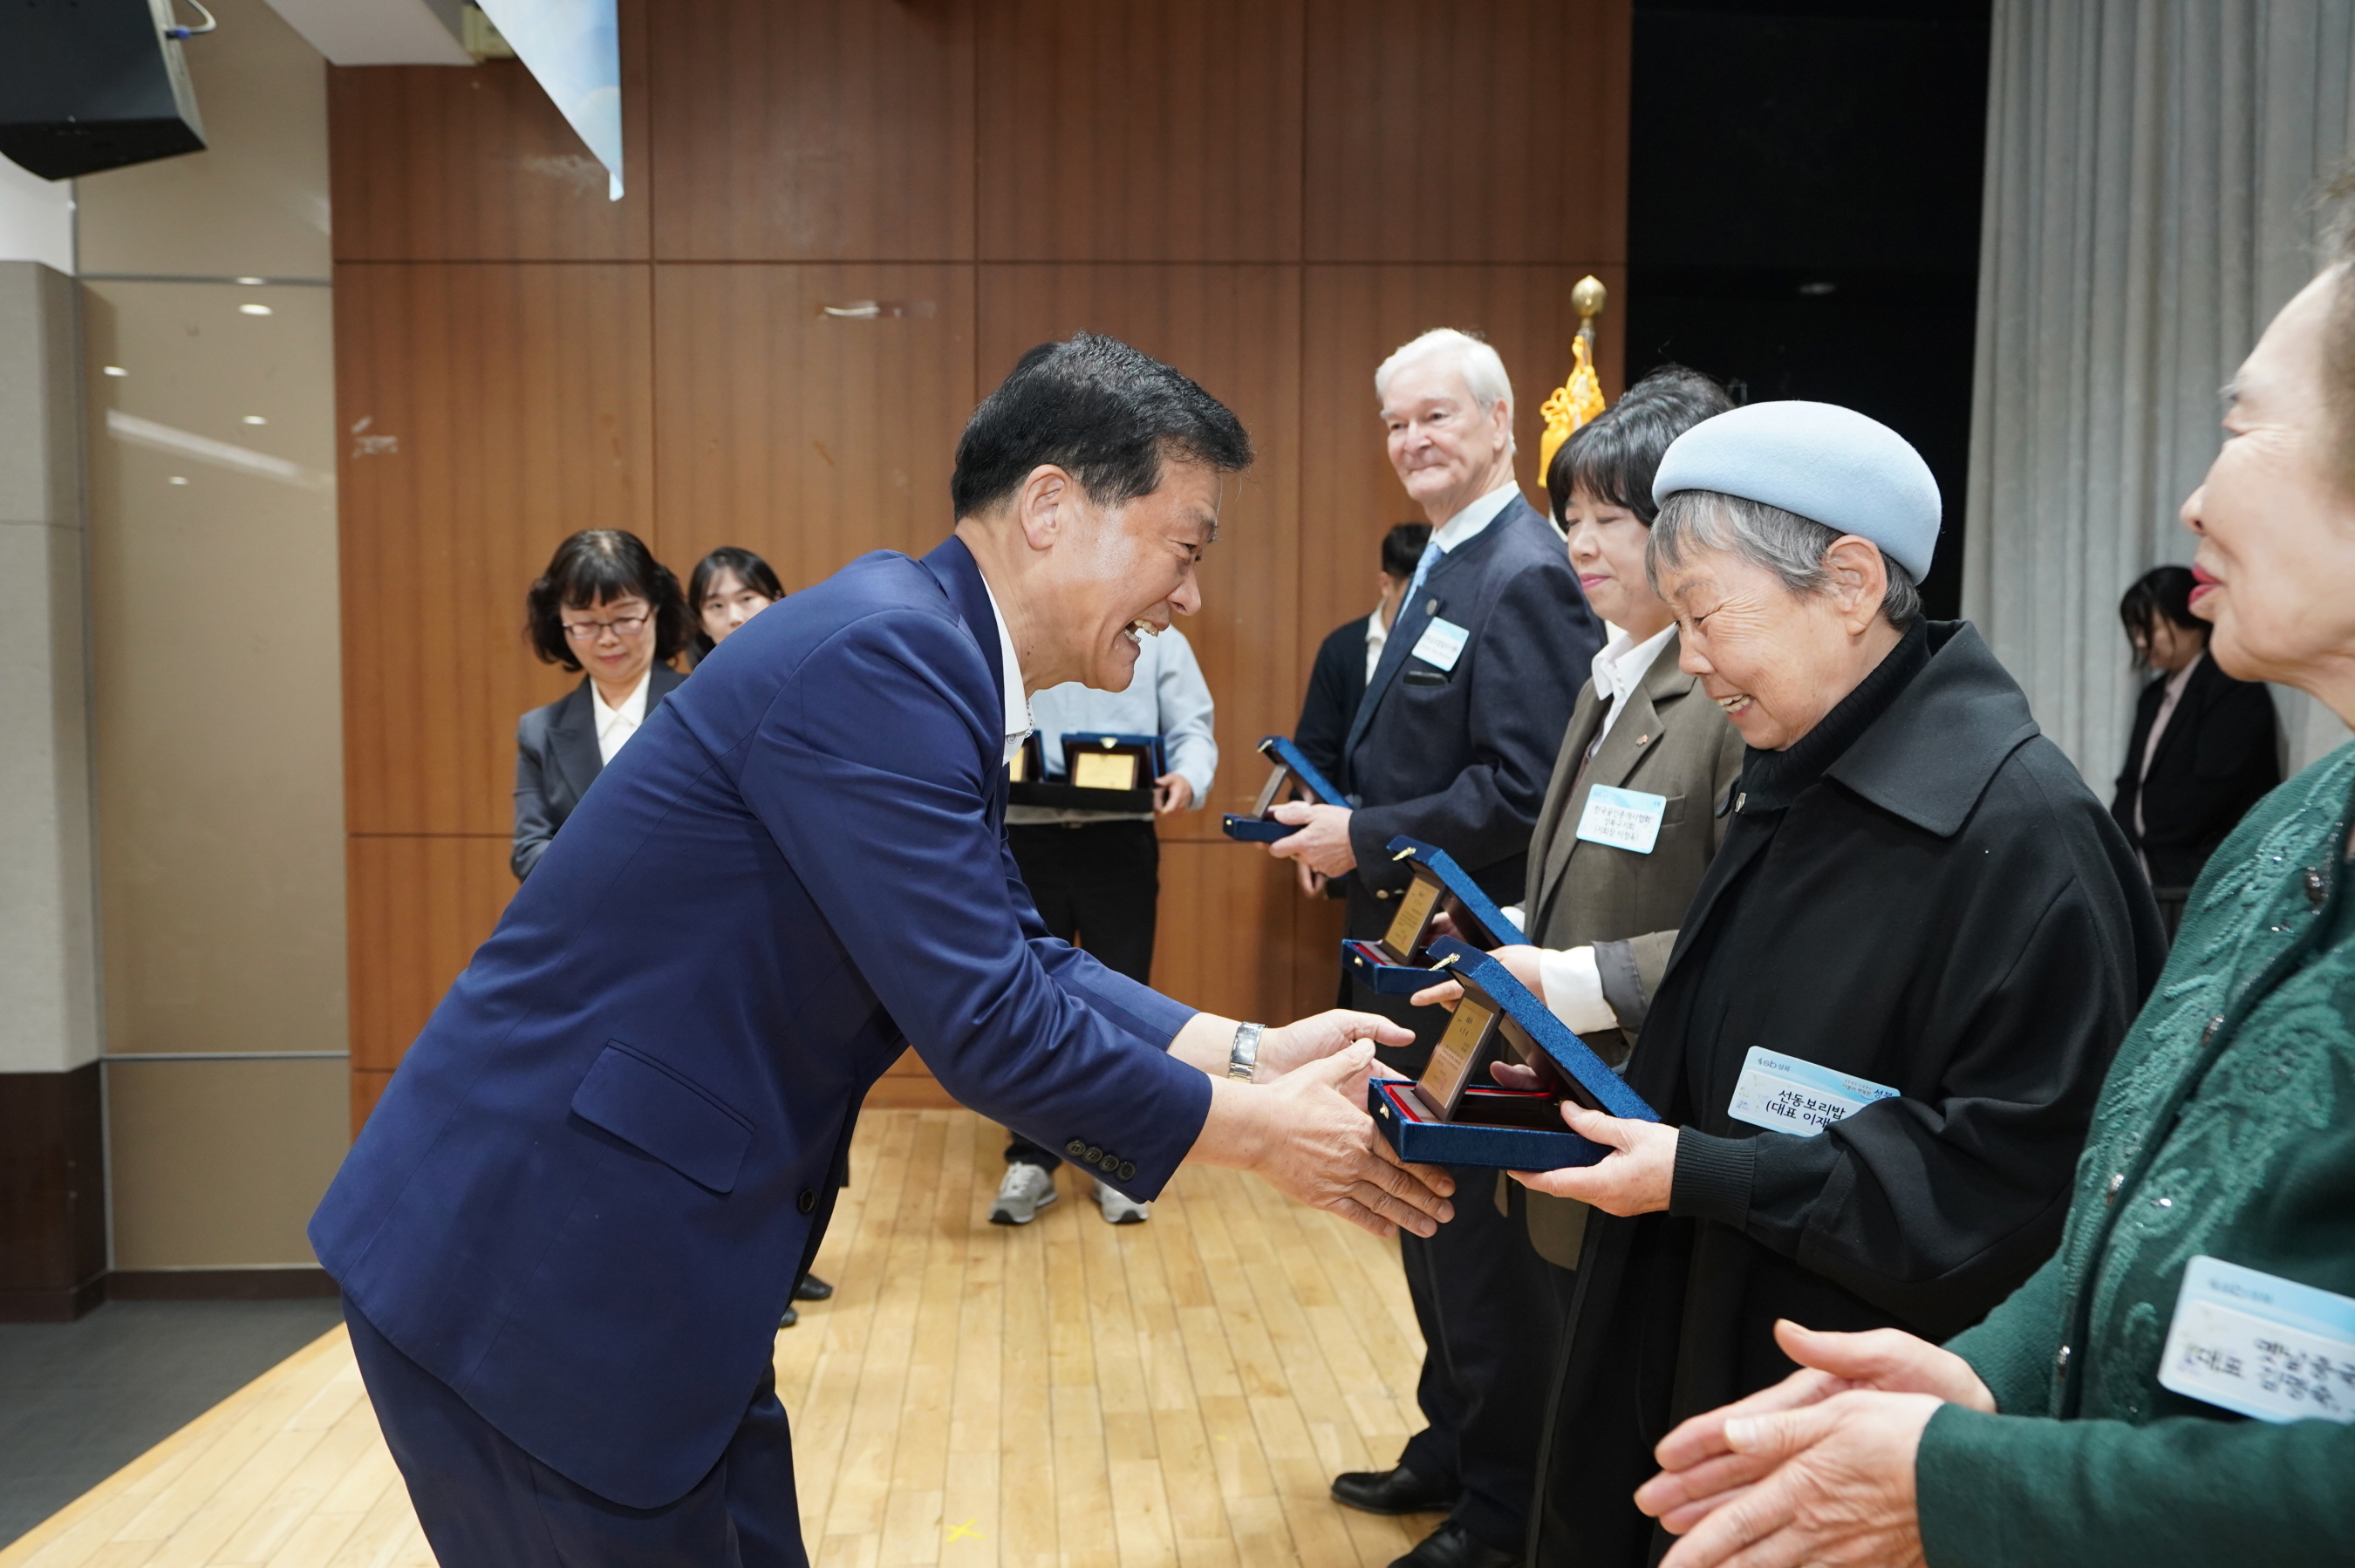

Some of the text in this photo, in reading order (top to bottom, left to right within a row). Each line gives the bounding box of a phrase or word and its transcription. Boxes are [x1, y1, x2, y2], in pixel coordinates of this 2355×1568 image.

[1594, 805, 1651, 823] 한국공인중개사협회
[1605, 818, 1635, 831] 성북구지회
[1765, 1100, 1797, 1120] (대표
[1778, 1089, 1846, 1121] 선동보리밥
